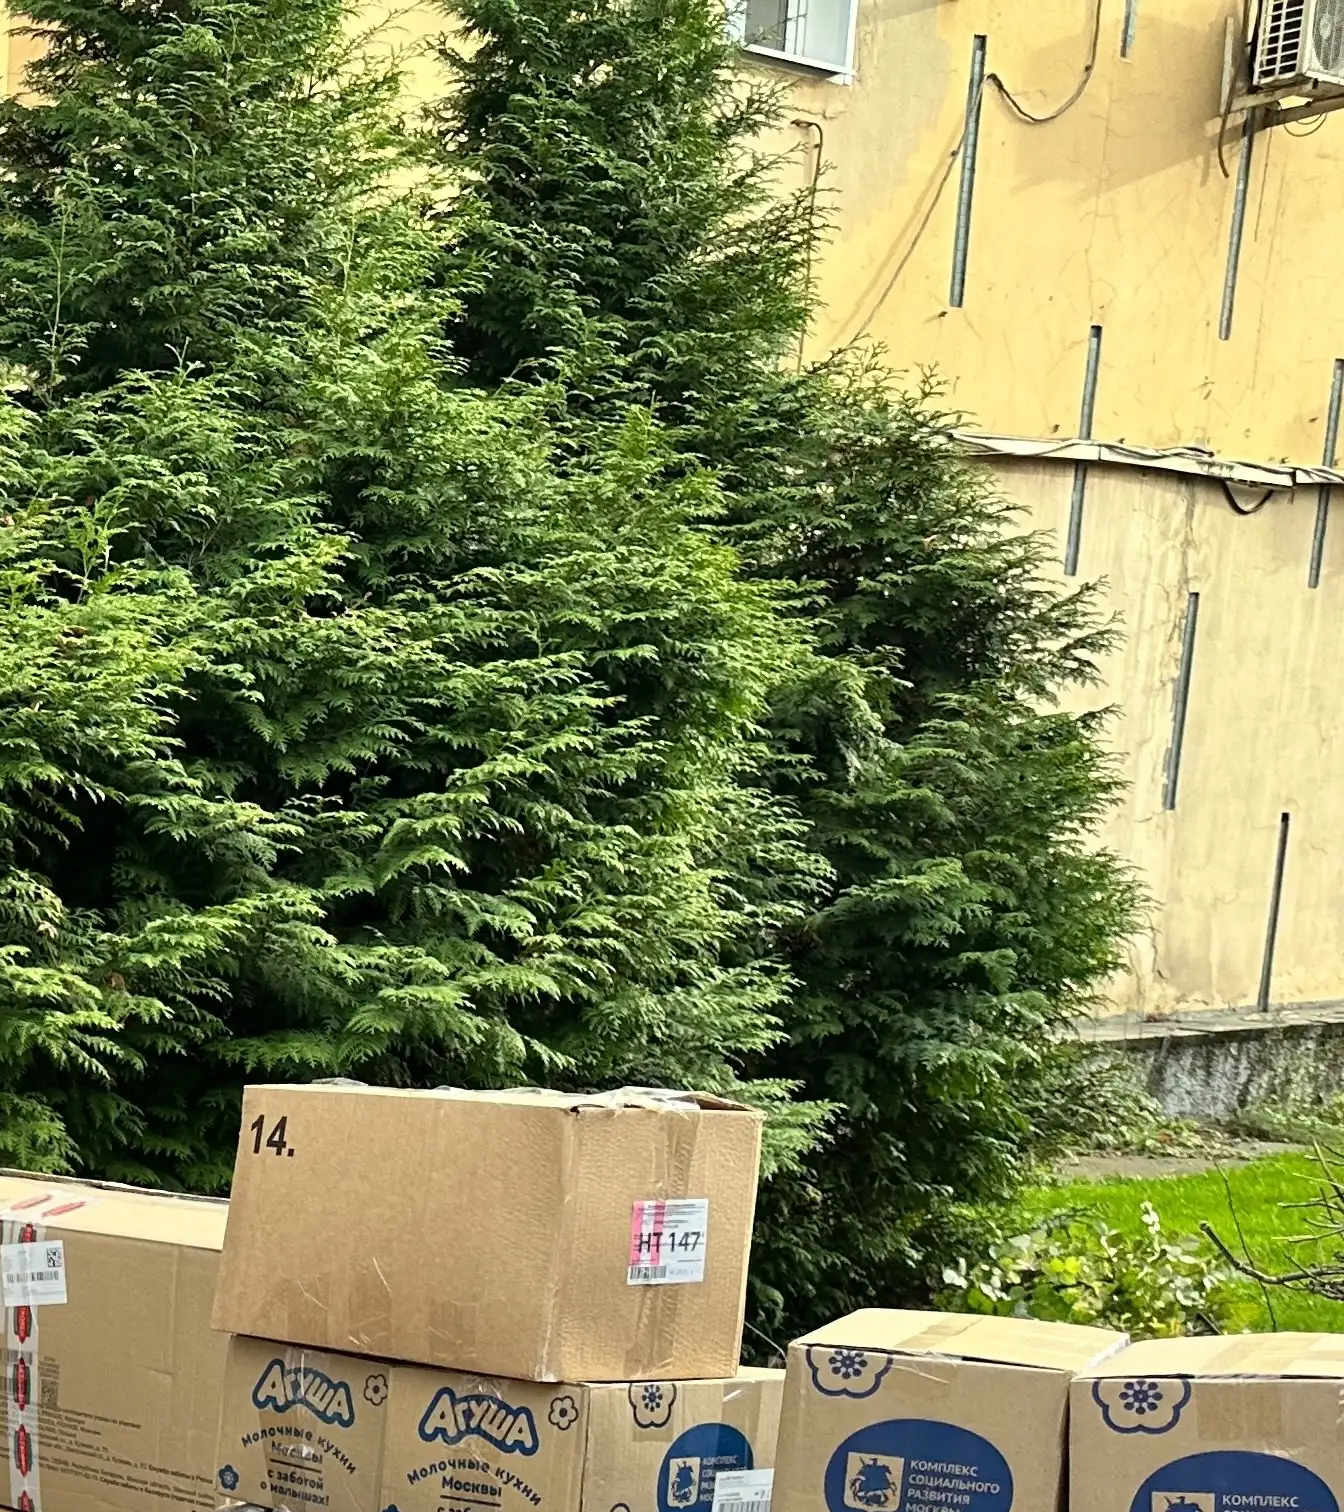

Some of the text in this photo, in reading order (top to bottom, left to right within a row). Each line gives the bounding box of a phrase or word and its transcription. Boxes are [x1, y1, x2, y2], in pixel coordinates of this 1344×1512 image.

[250, 1114, 296, 1158] 14.
[669, 1231, 701, 1252] 147
[910, 1459, 978, 1478] КОМПЛЕКС
[406, 1459, 543, 1507] Молочные кухни
[441, 1474, 503, 1498] Москвы
[908, 1474, 1000, 1494] СОЦИАЛЬНОГО
[907, 1488, 970, 1506] РАЗВИТИЯ
[1222, 1494, 1300, 1509] КОМПЛЕКС
